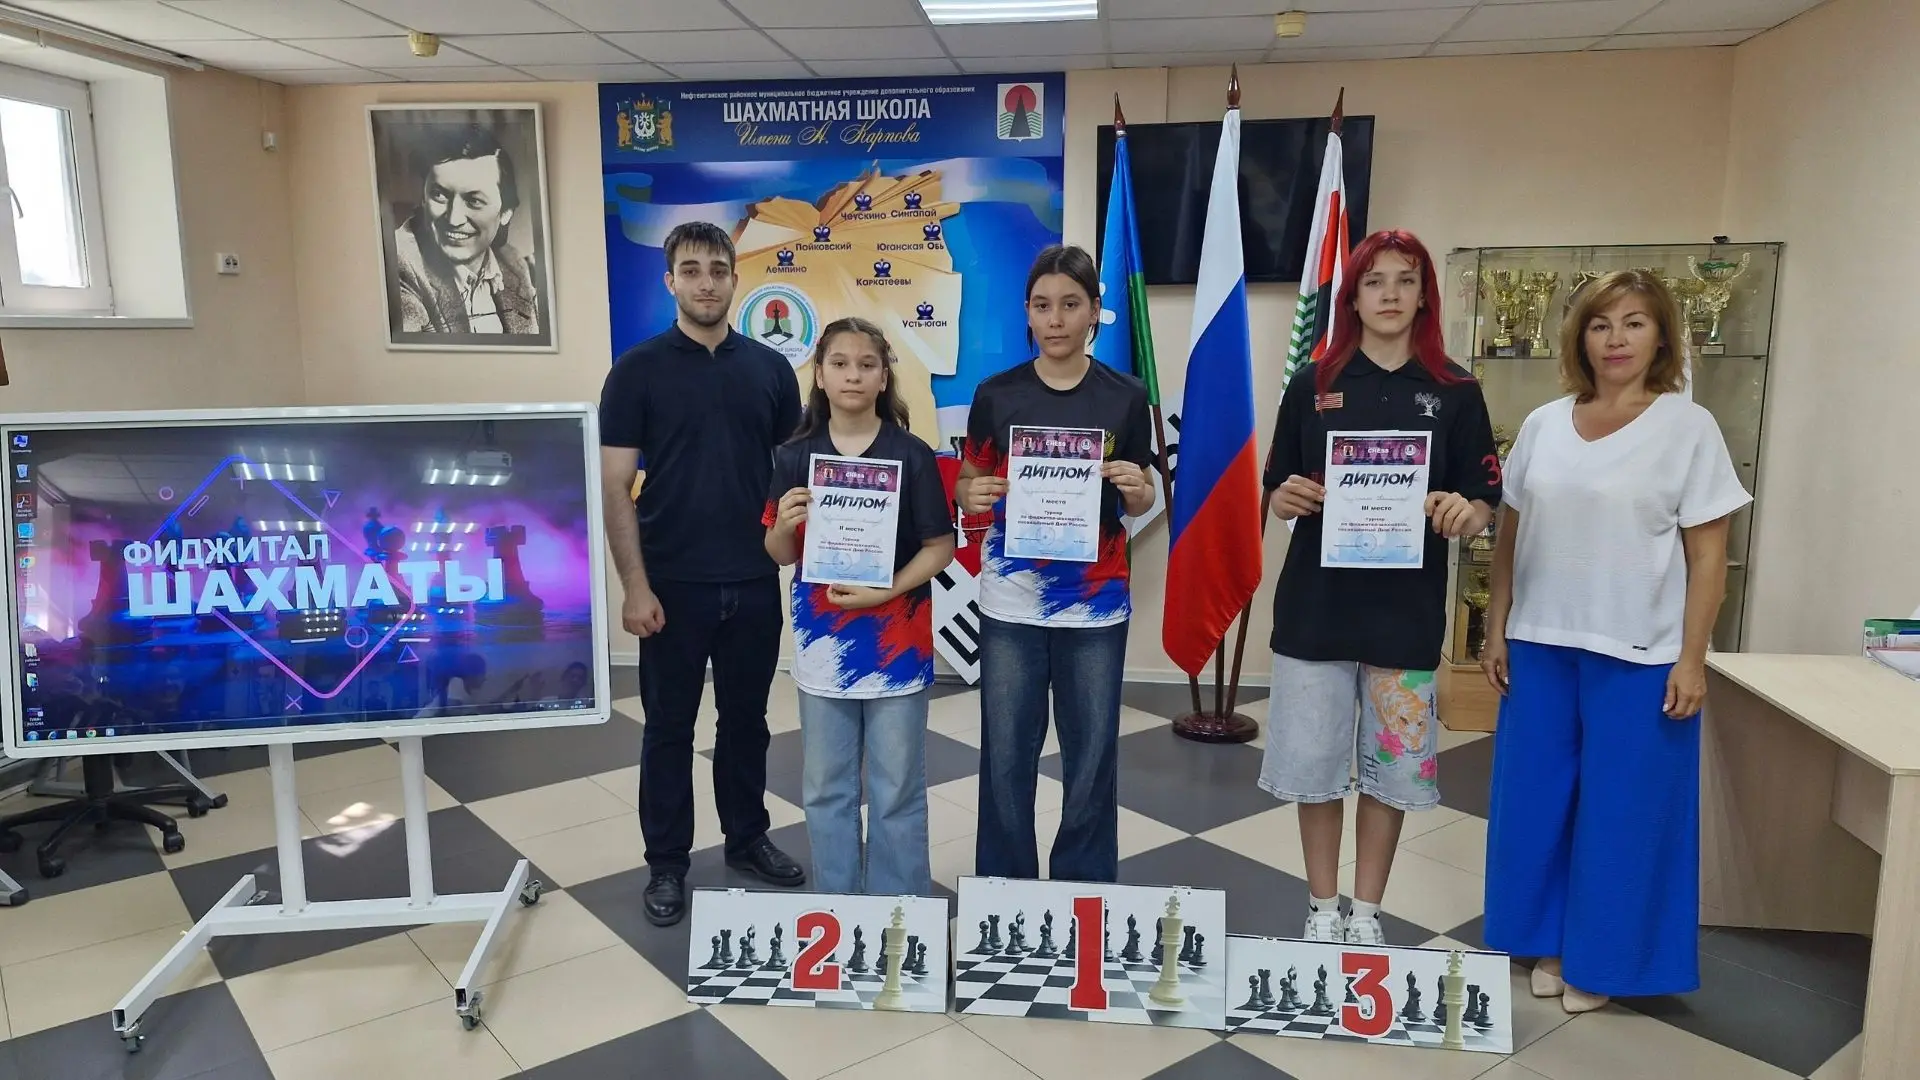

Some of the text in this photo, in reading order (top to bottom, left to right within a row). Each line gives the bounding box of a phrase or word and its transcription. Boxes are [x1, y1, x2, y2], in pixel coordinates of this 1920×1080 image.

[680, 86, 975, 100] Нефтеюганское районное муниципальное бюджетное учреждение дополнительного образования
[723, 98, 932, 122] ШАХМАТНАЯ ШКОЛА
[735, 119, 921, 153] Имени А. Карпова
[840, 209, 937, 221] Чеускино Сингапай
[796, 242, 852, 251] Пойковский
[877, 242, 945, 251] Юганская Обь
[766, 265, 807, 274] Лемпино
[856, 278, 912, 287] Каркатеевы
[902, 320, 947, 328] Усть-юган
[1019, 463, 1094, 483] ДИПЛОМ
[1339, 469, 1418, 489] ДИПЛОМ
[820, 492, 889, 513] ДИПЛОМ
[124, 534, 330, 570] ФИДЖИТАЛ
[127, 558, 505, 617] ШАХМАТЫ
[792, 911, 842, 991] 2
[1069, 896, 1108, 1010] 1
[1340, 951, 1394, 1037] 3
